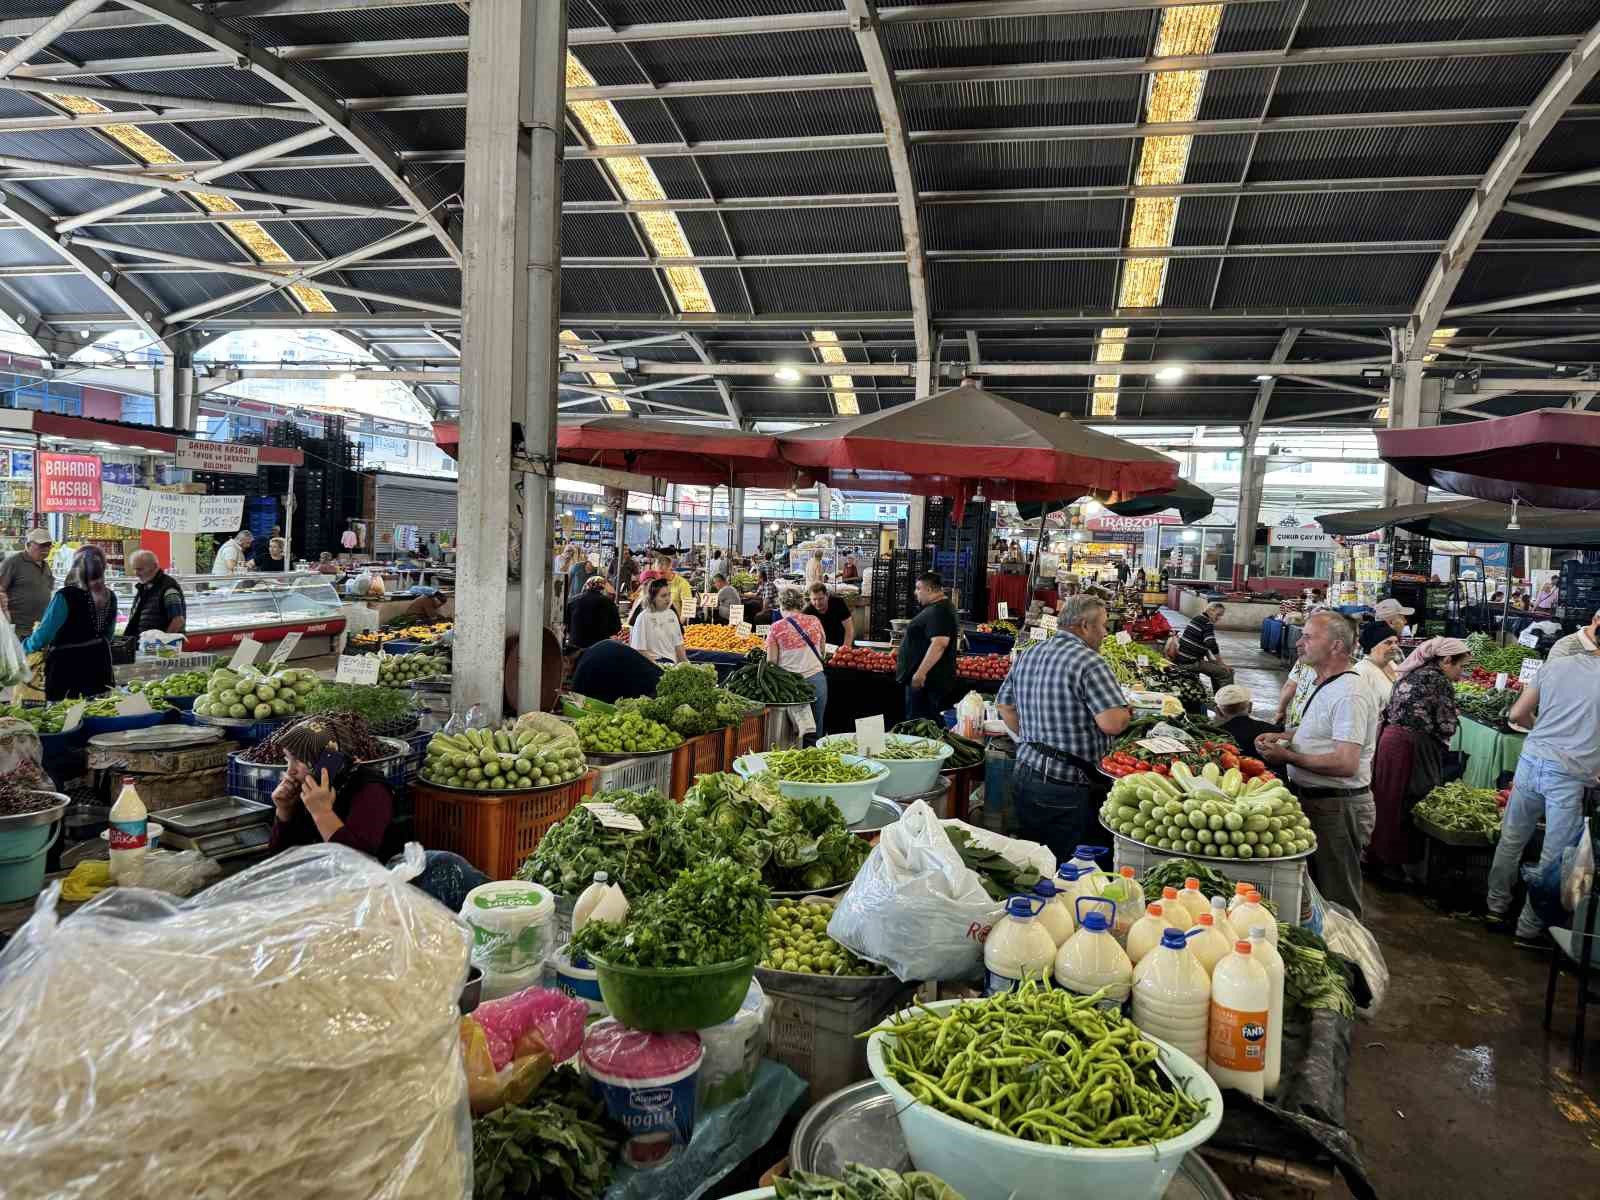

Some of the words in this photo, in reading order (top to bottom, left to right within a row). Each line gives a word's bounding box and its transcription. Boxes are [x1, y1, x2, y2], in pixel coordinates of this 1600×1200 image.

[189, 441, 222, 453] BAHADIR
[225, 446, 251, 456] KASABI
[193, 451, 213, 460] TAVUK
[46, 460, 96, 477] BAHADIR
[50, 480, 92, 496] KASABI
[1099, 517, 1162, 528] TRABZON
[1277, 534, 1299, 542] ÇUKUR
